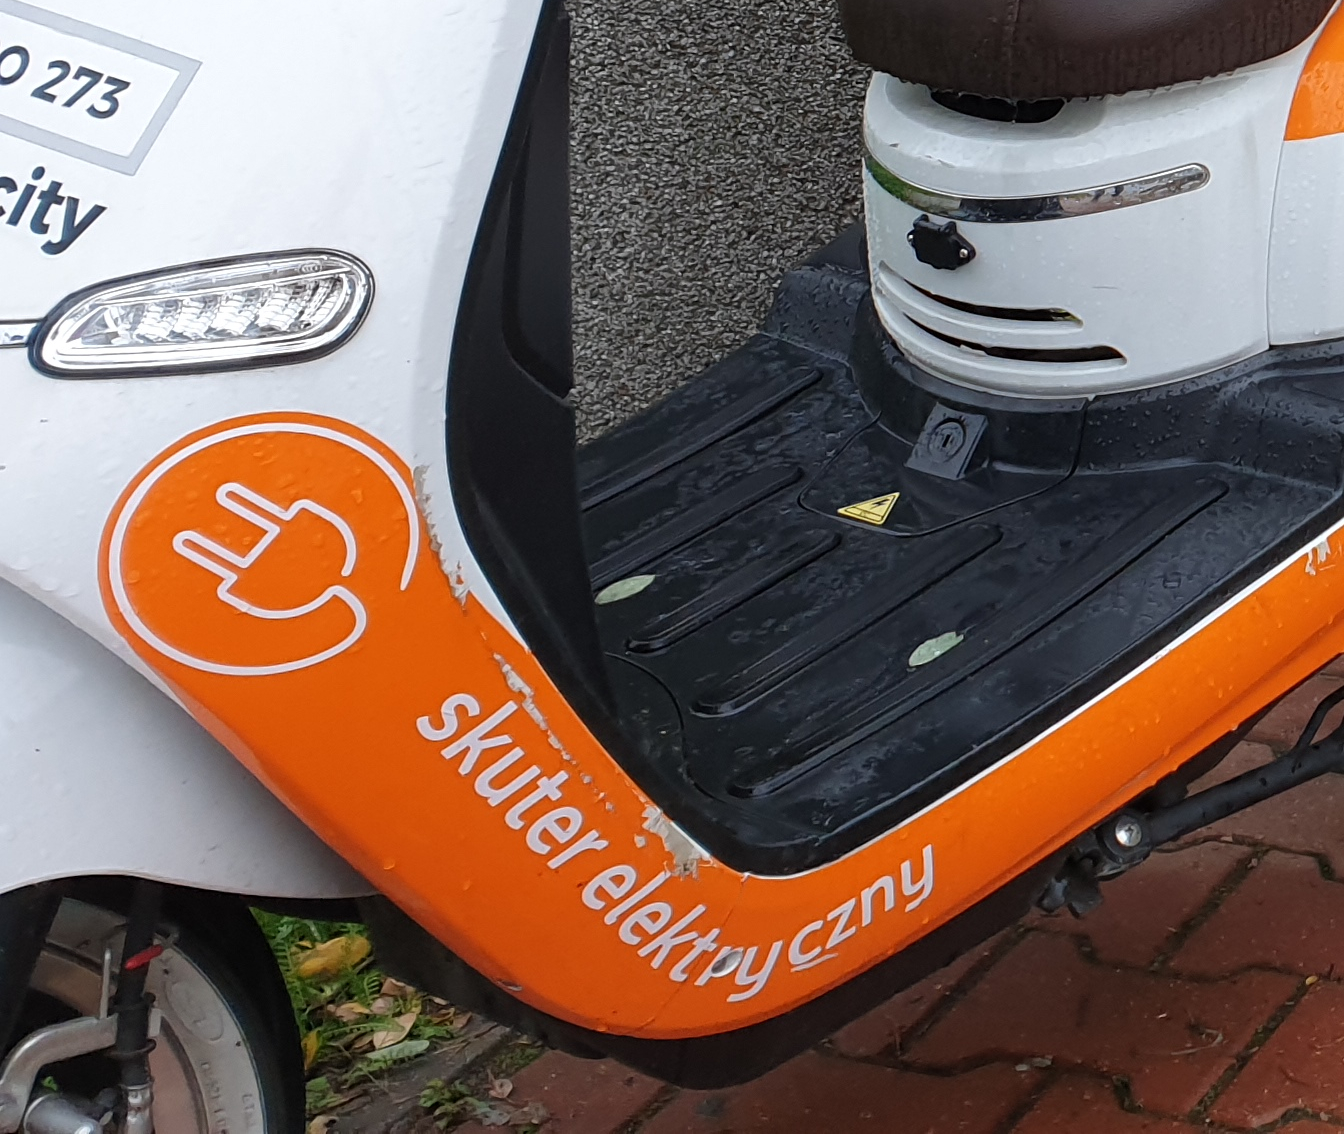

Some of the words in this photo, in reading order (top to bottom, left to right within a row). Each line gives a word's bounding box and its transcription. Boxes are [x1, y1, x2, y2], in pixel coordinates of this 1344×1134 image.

[30, 60, 131, 119] 273
[416, 693, 609, 869] skuter
[581, 843, 934, 1002] elektryczny
